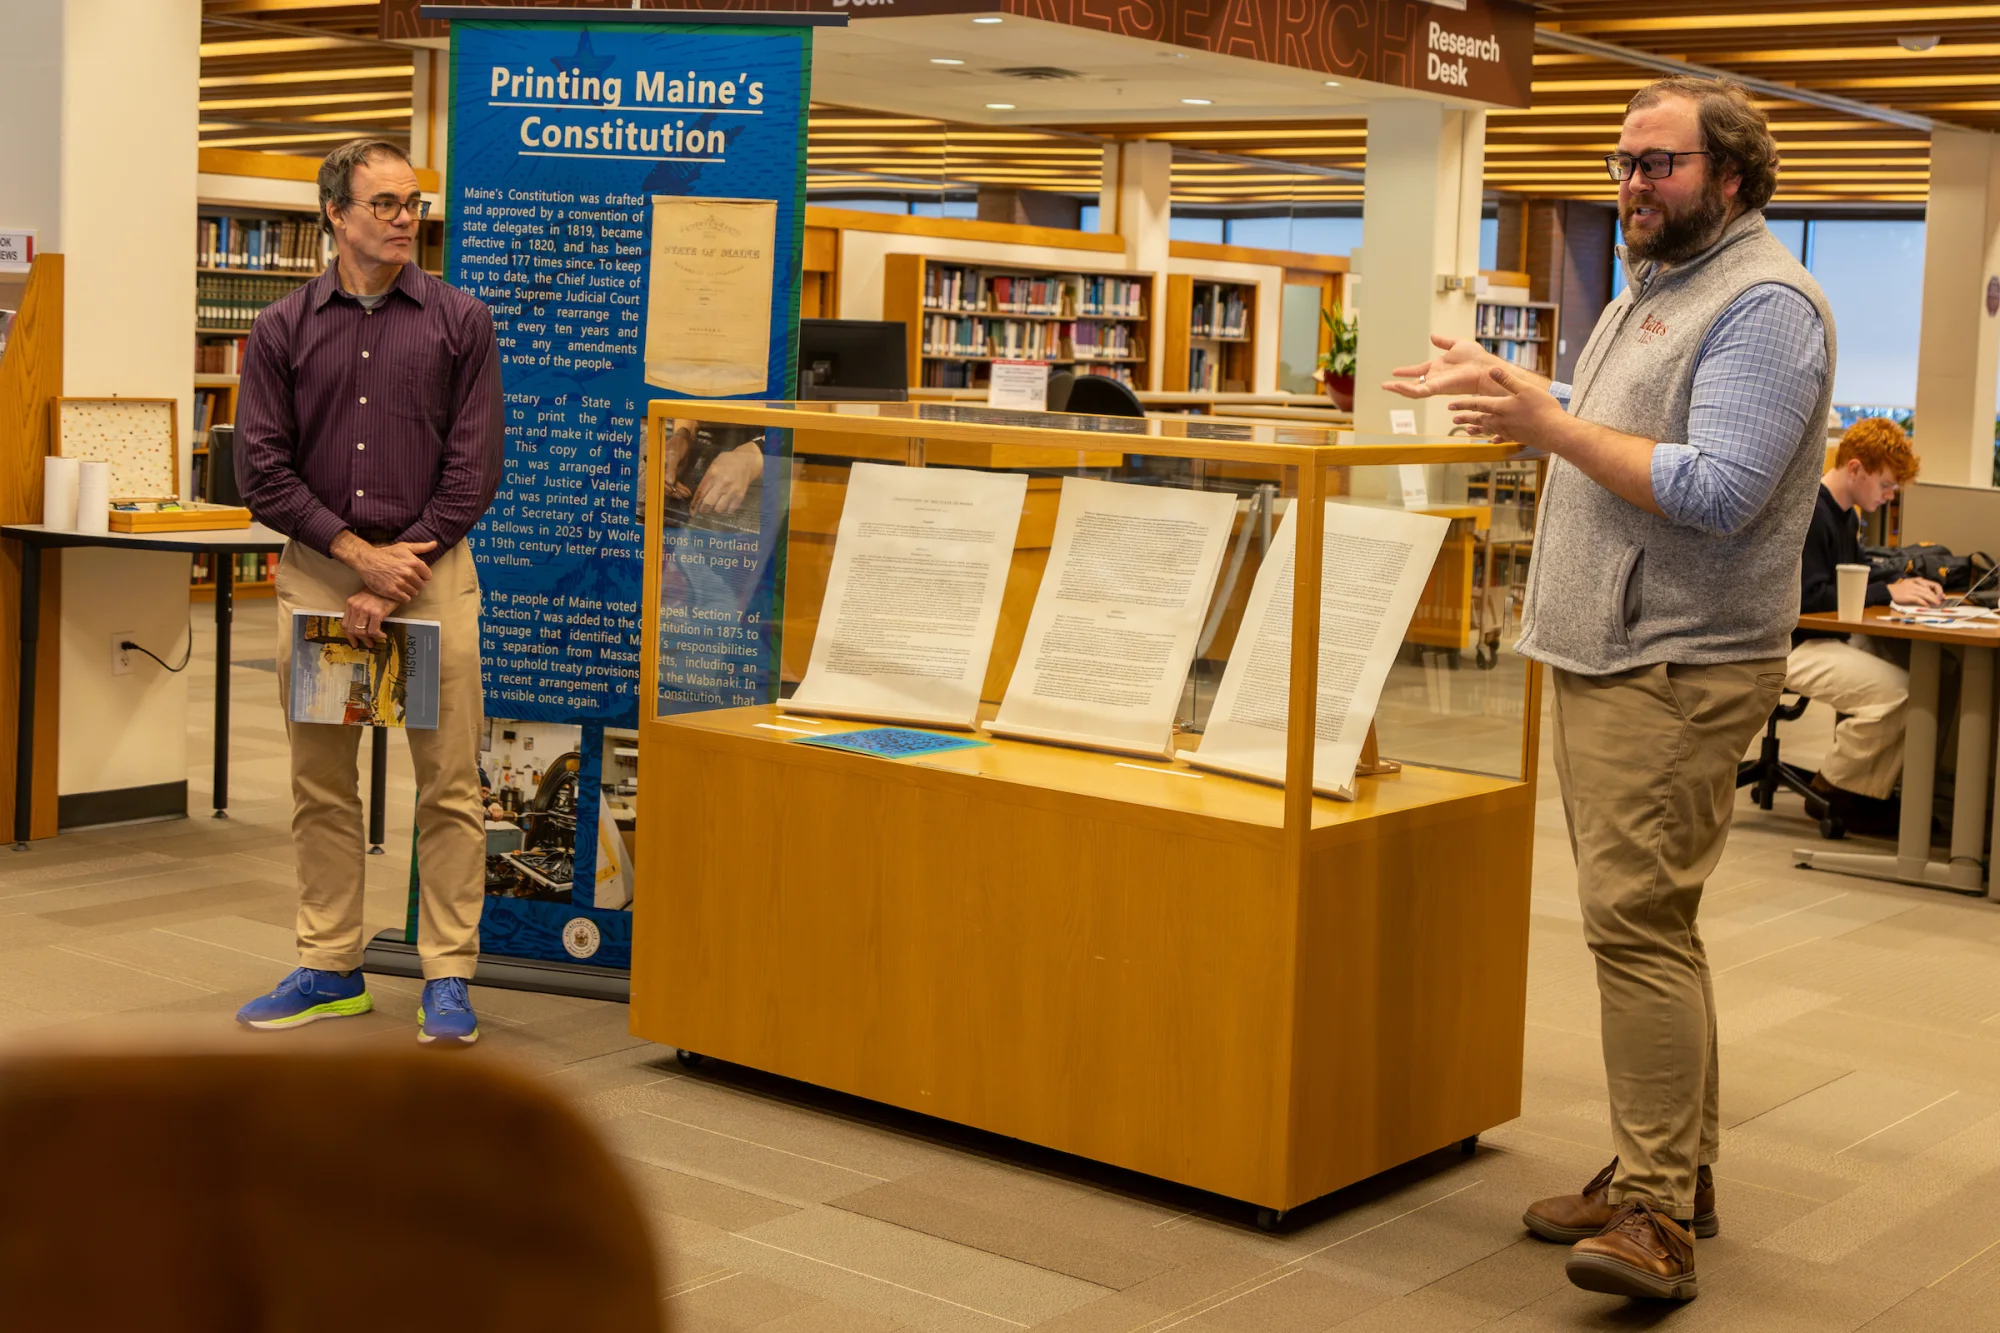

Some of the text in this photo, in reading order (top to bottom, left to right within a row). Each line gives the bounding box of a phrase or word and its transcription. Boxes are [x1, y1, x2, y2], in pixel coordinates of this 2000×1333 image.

[1428, 20, 1500, 63] Research
[1427, 53, 1468, 87] Desk
[490, 66, 764, 107] Printing Maine's
[520, 115, 726, 154] Constitution
[464, 187, 644, 206] Maine's Constitution was drafted
[463, 203, 644, 223] and approved by convention of
[463, 221, 643, 239] state delegates in 1819, became
[462, 235, 642, 256] effective in 1820, and has been
[461, 253, 642, 275] amended 177 times since. To keep
[471, 270, 641, 289] up to date, the Chief Justice of
[479, 285, 511, 299] Maine
[514, 287, 563, 302] Supreme
[565, 290, 606, 303] Judicial
[609, 292, 640, 305] Court
[533, 305, 639, 323] to rearrange the
[517, 322, 547, 336] every
[554, 323, 573, 334] ten
[580, 326, 609, 338] years
[617, 326, 638, 338] and
[532, 339, 552, 353] any
[567, 341, 637, 355] amendments
[512, 353, 614, 372] vote of the people.
[554, 394, 634, 410] of State is
[513, 409, 634, 426] to print the new
[526, 426, 547, 437] and
[551, 427, 582, 440] make
[585, 429, 593, 440] it
[596, 430, 633, 446] widely
[515, 440, 632, 460] This copy of the
[528, 461, 549, 470] was
[559, 462, 611, 477] arranged
[620, 464, 631, 476] in
[506, 473, 631, 492] Chief Justice Valerie
[494, 489, 630, 509] and was printed at the
[503, 505, 515, 516] of
[522, 506, 575, 524] Secretary
[581, 510, 594, 522] of
[600, 511, 630, 525] State
[492, 520, 534, 535] Bellows
[539, 524, 549, 535] in
[555, 525, 583, 538] 2025
[588, 527, 603, 543] by
[607, 529, 640, 543] Wolfe
[693, 536, 704, 547] in
[709, 537, 759, 552] Portland
[491, 537, 759, 572] 19th century letter press each page by
[493, 554, 534, 567] vellum.
[490, 590, 508, 602] the
[511, 593, 549, 607] people
[552, 595, 565, 607] of
[569, 596, 602, 610] Maine
[606, 601, 637, 613] voted
[692, 606, 732, 622] Section
[735, 611, 744, 622] 7
[747, 611, 761, 624] of
[492, 606, 531, 620] Section
[533, 609, 541, 621] 7
[543, 613, 563, 623] was
[566, 613, 601, 626] added
[603, 616, 615, 627] to
[617, 616, 635, 629] the
[703, 625, 713, 637] in
[717, 626, 743, 639] 1875
[746, 629, 759, 641] to
[483, 622, 531, 639] language
[539, 626, 561, 639] that
[569, 629, 621, 644] identified
[676, 641, 758, 657] responsibilities
[406, 634, 417, 677] HISTORY
[483, 638, 757, 675] its separation from including an
[496, 657, 508, 667] to
[511, 657, 548, 671] uphold
[550, 661, 583, 677] treaty
[585, 665, 639, 679] provisions
[666, 671, 684, 684] the
[686, 672, 742, 689] Wabanaki.
[744, 677, 756, 690] In
[490, 687, 499, 699] is
[501, 689, 535, 702] visible
[538, 694, 564, 705] once
[567, 695, 600, 709] again.
[499, 674, 532, 686] recent
[539, 678, 608, 692] arrangement
[615, 682, 628, 694] of
[657, 686, 724, 706] Constitution,
[731, 694, 756, 706] that
